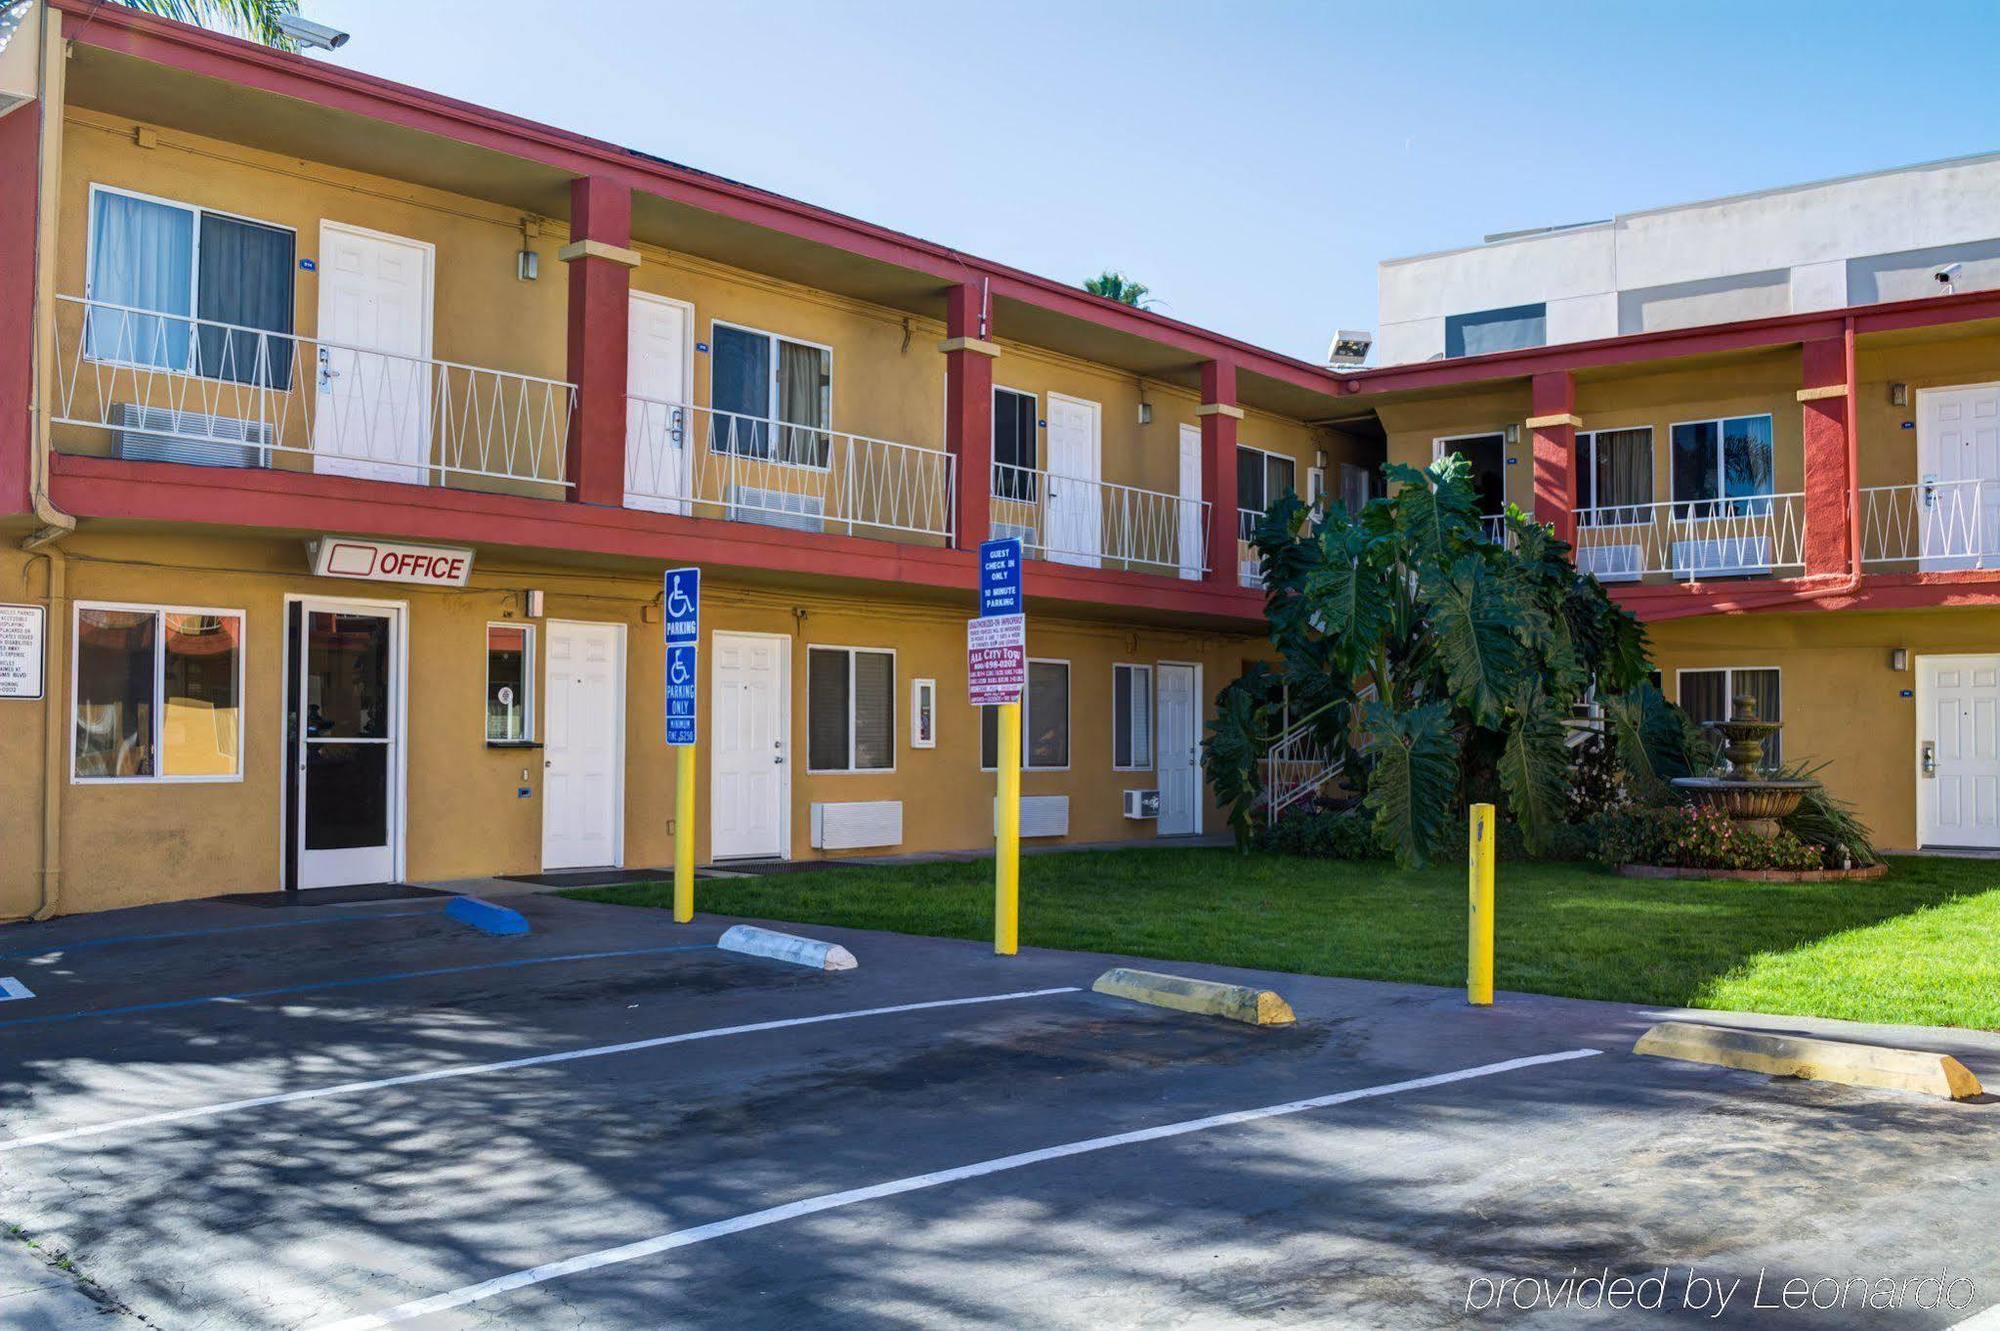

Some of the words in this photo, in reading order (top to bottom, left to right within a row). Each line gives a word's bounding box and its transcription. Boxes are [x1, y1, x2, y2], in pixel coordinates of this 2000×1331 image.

[990, 549, 1009, 558] GUEST
[380, 552, 464, 580] OFFICE
[984, 560, 1006, 570] CHECK
[1008, 559, 1015, 568] IN
[992, 571, 1008, 580] ONLY
[992, 586, 1016, 596] MINUTE
[986, 598, 1014, 608] PARKING
[667, 620, 696, 636] PARKING
[970, 652, 982, 664] ALL
[984, 650, 1002, 660] CITY
[1003, 648, 1021, 660] TOW
[667, 685, 694, 699] PARKING
[672, 700, 689, 714] ONLY
